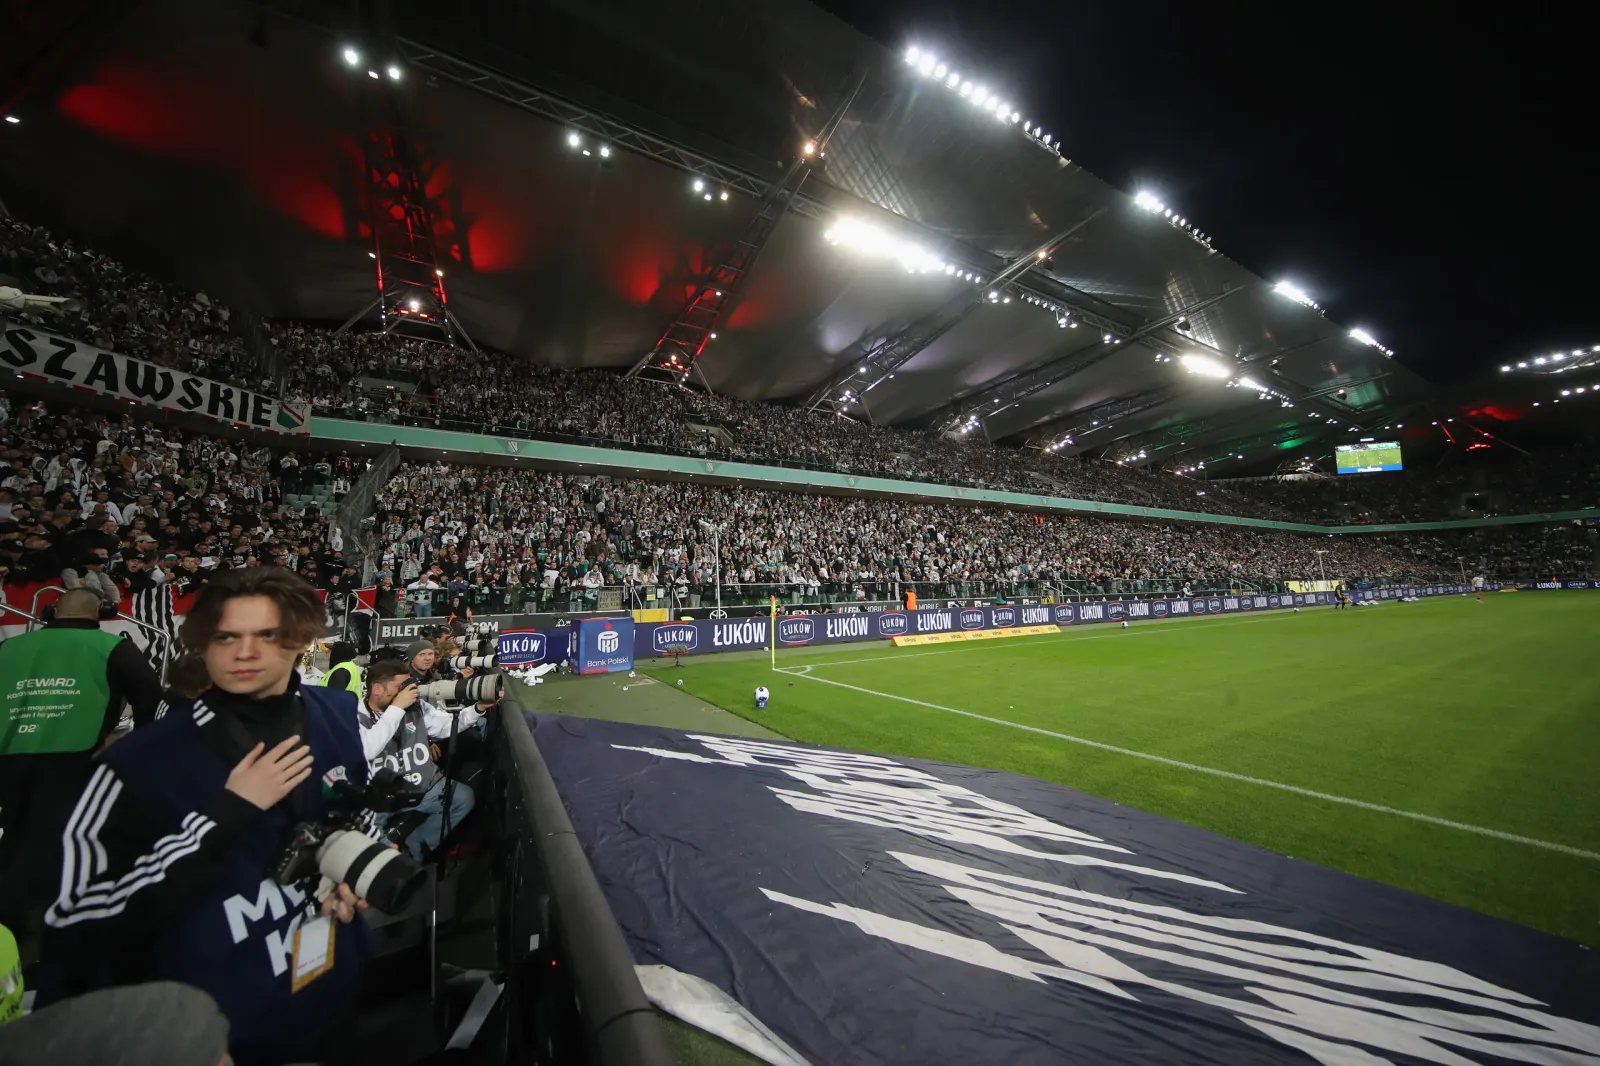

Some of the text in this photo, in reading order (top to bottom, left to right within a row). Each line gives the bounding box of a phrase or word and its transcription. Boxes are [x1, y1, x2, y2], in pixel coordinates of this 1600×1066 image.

[1022, 604, 1049, 624] ŁUKÓW
[1080, 602, 1103, 620] ŁUKÓW
[1129, 600, 1149, 617] ŁUKÓW
[782, 621, 811, 636] ŁUKÓW
[826, 613, 869, 638] ŁUKÓW
[881, 616, 905, 629] ŁUKÓW
[917, 609, 952, 632] ŁUKÓW
[657, 628, 694, 644] ŁUKÓW
[713, 619, 766, 646] ŁUKÓW
[497, 637, 541, 656] UKÓW
[608, 656, 629, 665] Polski
